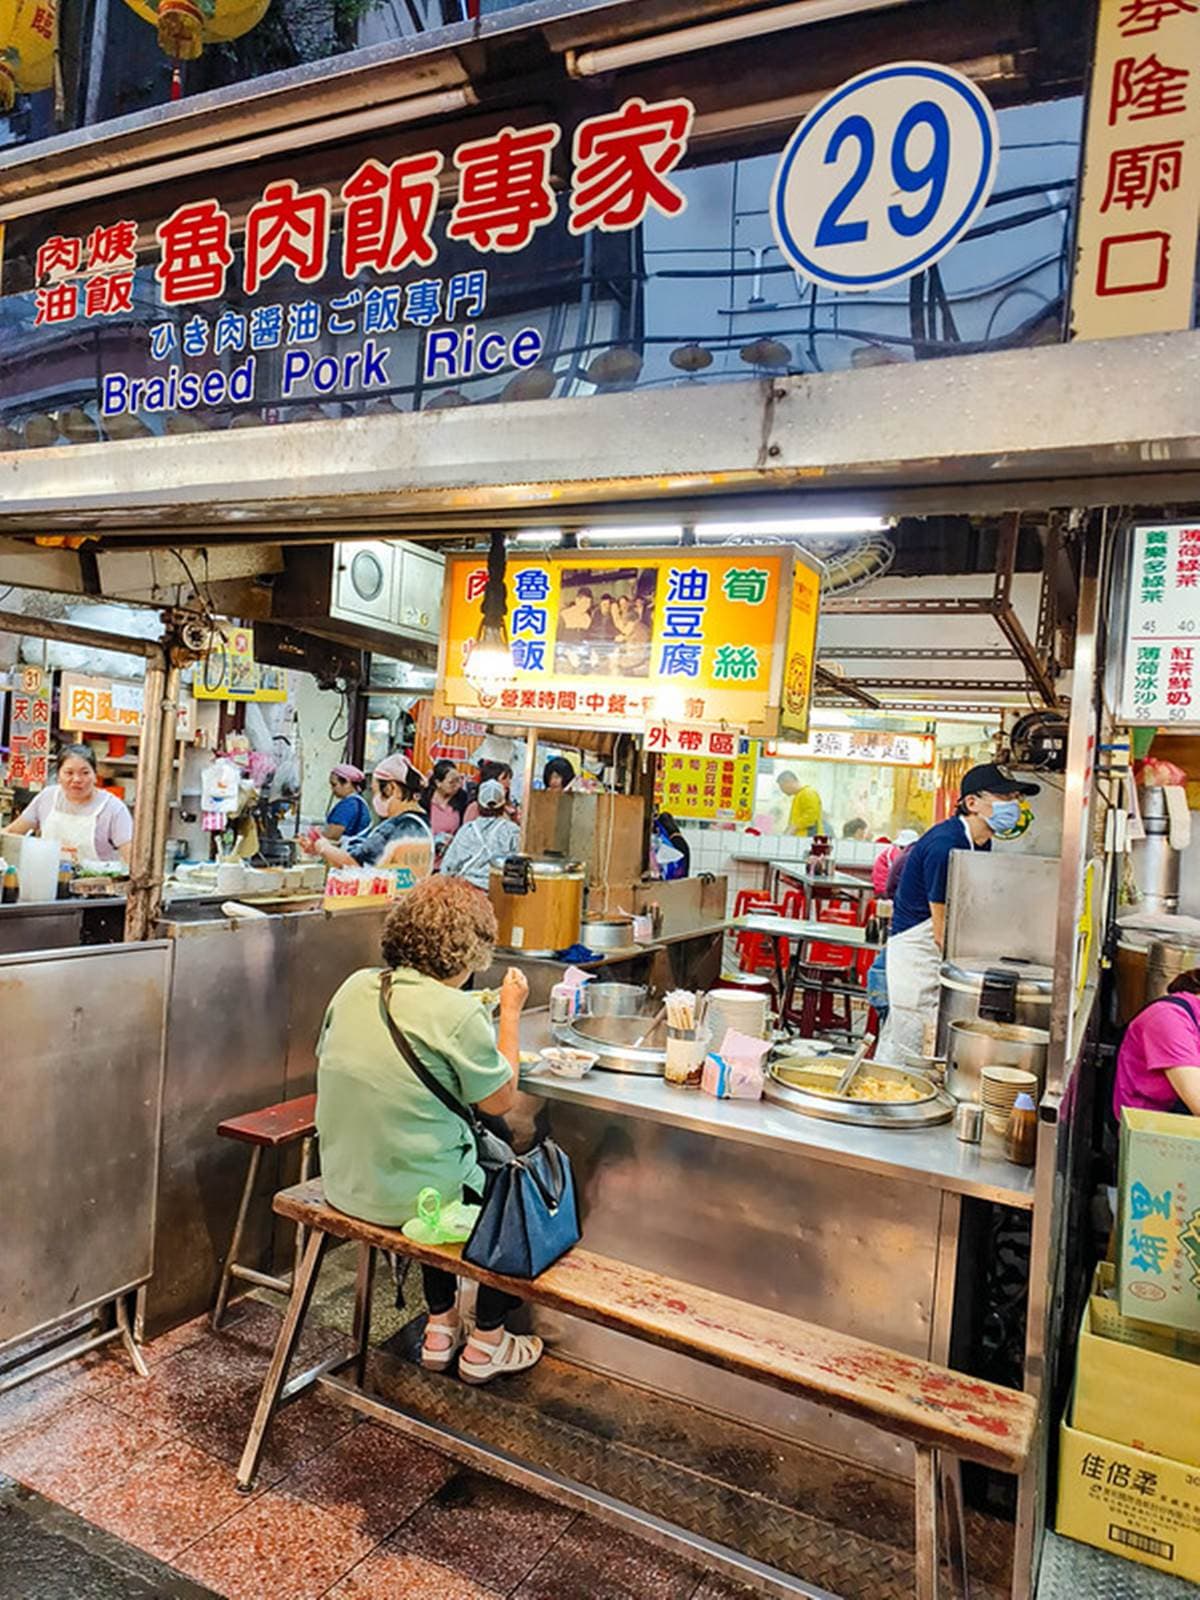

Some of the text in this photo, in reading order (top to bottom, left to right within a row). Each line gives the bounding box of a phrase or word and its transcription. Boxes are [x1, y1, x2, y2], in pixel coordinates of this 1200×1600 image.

[157, 98, 694, 303] 魯肉飯專家
[814, 101, 951, 248] 29
[35, 272, 135, 325] 油飯
[102, 326, 542, 416] Braised Pork Rice
[511, 569, 550, 672] 魯肉飯
[659, 569, 708, 677] 油豆腐
[714, 569, 768, 679] 筍絲
[1142, 620, 1156, 633] 45
[1178, 620, 1195, 632] 40
[26, 671, 38, 687] 31
[1166, 647, 1194, 705] 紅茶鮮奶
[648, 726, 735, 755] 外帶區
[1169, 708, 1186, 721] 50
[1081, 1452, 1158, 1496] 佳倍柔
